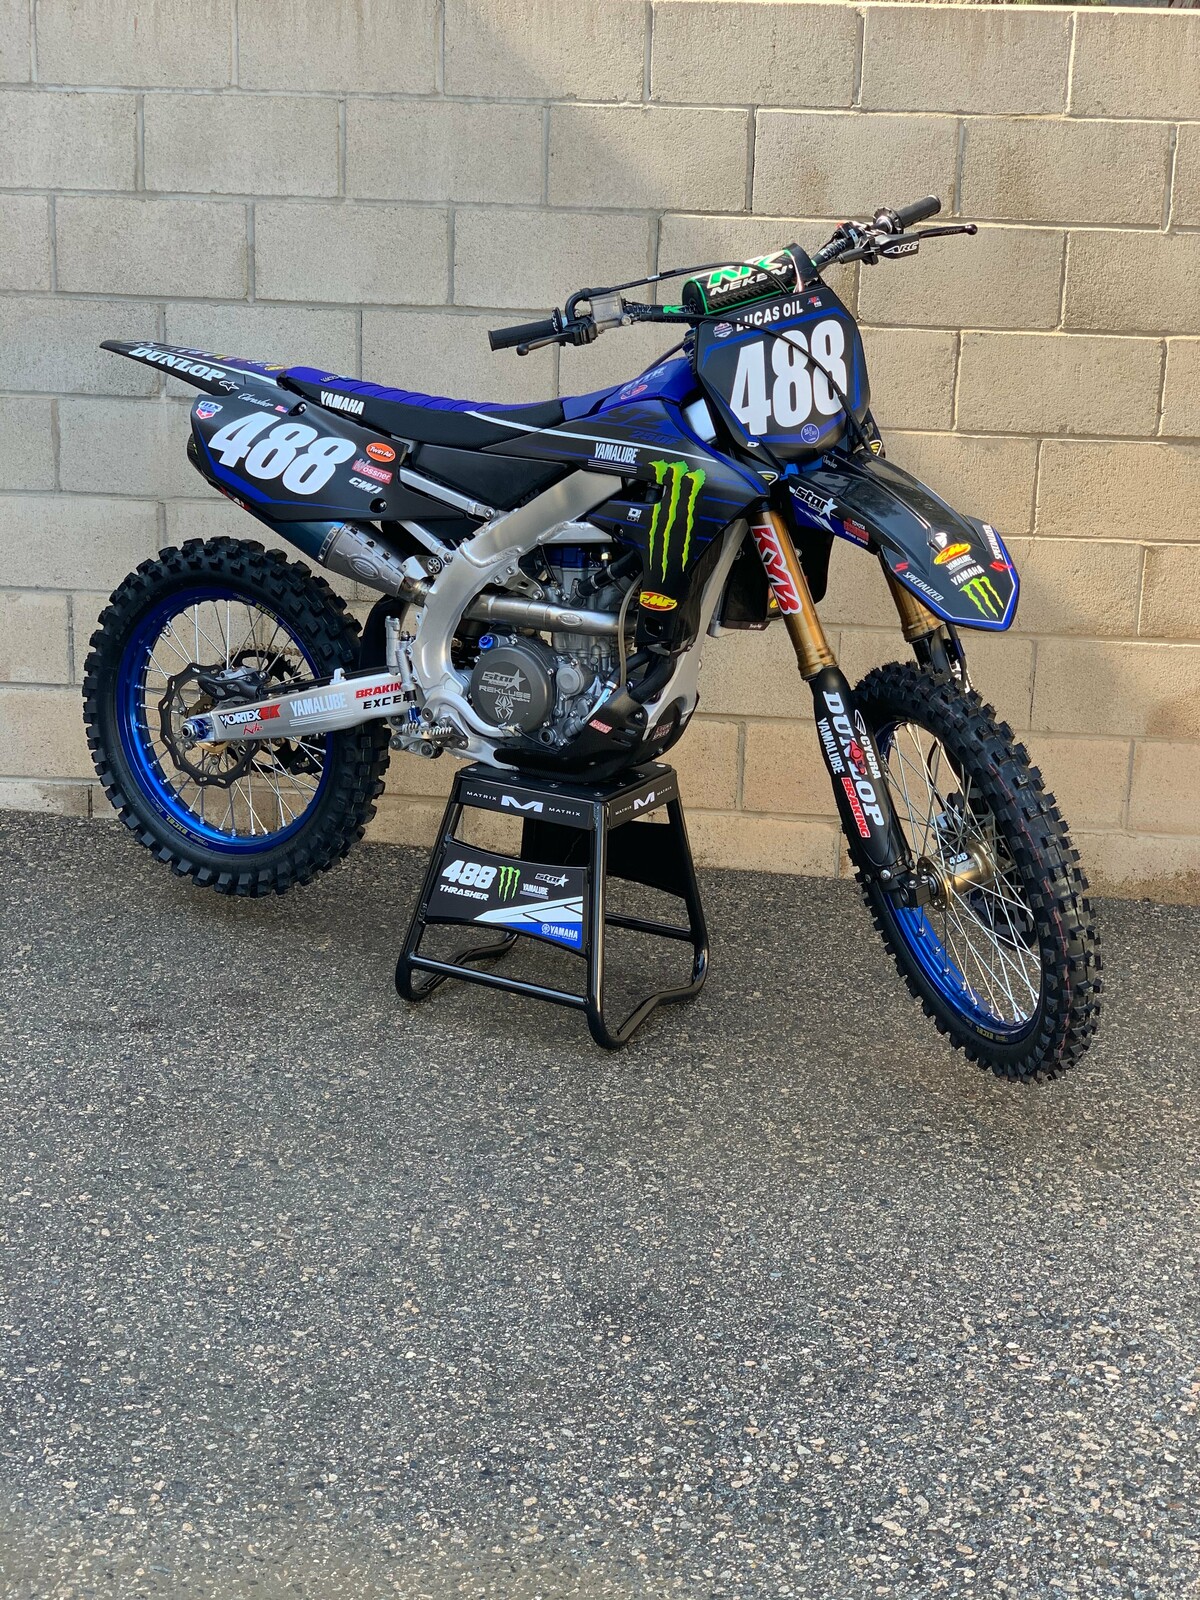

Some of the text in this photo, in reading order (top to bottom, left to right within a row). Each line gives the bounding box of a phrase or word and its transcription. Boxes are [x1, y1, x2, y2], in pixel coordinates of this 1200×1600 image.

[783, 301, 803, 317] OIL
[128, 347, 226, 382] DUNLOP
[730, 319, 848, 436] 488
[320, 390, 365, 415] YAMAHA
[208, 411, 357, 495] 488
[593, 442, 639, 464] YAMALUBE
[750, 524, 802, 615] KYB
[951, 565, 985, 586] YAMAHA
[903, 571, 945, 602] SPECIALIZED
[640, 594, 677, 608] FMF
[355, 682, 403, 699] BRAKIN
[479, 684, 531, 700] REKLUSE
[289, 691, 347, 718] YAMALUBE
[219, 708, 263, 729] VORTEX
[817, 717, 846, 775] YAMALUBE
[860, 735, 882, 779] CYCRA
[466, 790, 497, 801] MATRIX
[548, 806, 581, 817] MATRIX
[615, 805, 632, 816] MATRIX
[656, 785, 673, 796] MATRIX
[841, 777, 871, 838] BRAKING
[441, 860, 498, 890] 488
[440, 884, 490, 901] THRASHER
[522, 883, 549, 896] YAMALUBE
[549, 926, 578, 940] YAMAHA
